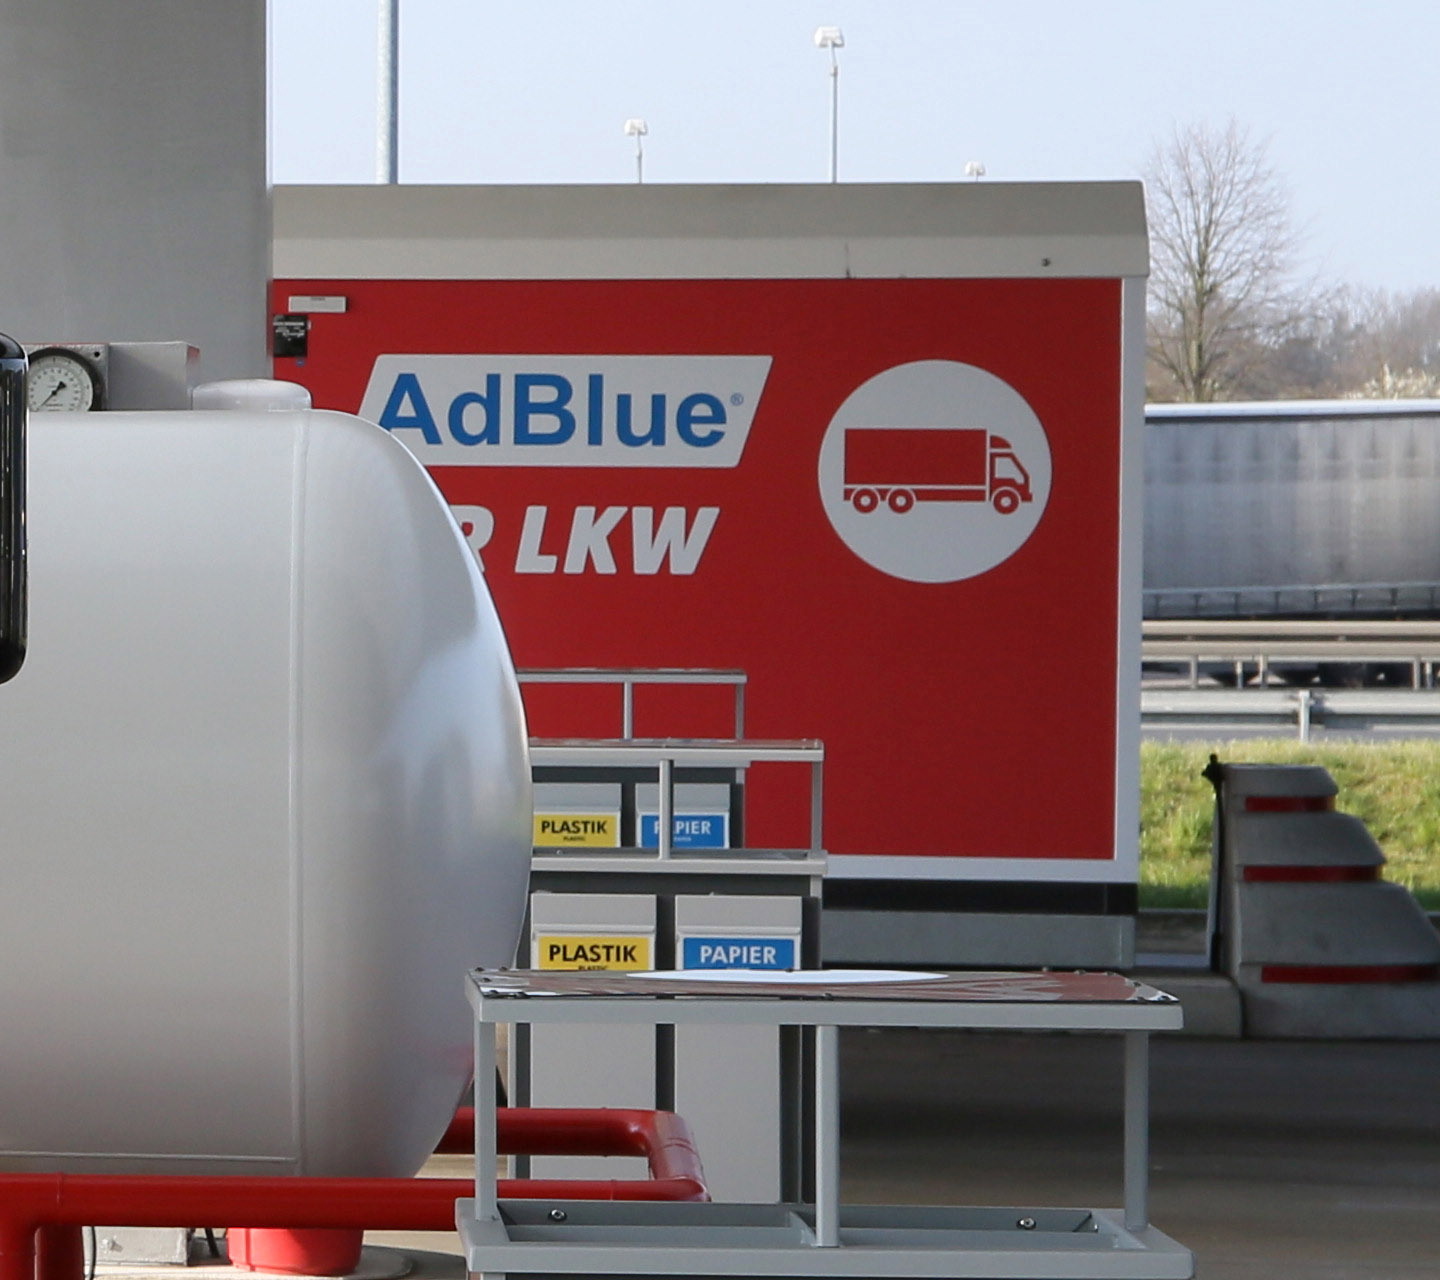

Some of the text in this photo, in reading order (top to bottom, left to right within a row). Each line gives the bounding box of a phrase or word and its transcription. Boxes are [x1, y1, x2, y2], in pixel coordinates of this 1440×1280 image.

[515, 505, 720, 575] LKW
[541, 820, 607, 834] PLASTIK
[654, 821, 711, 834] PPIER
[549, 944, 637, 963] PLASTIK
[700, 945, 776, 964] PAPIER
